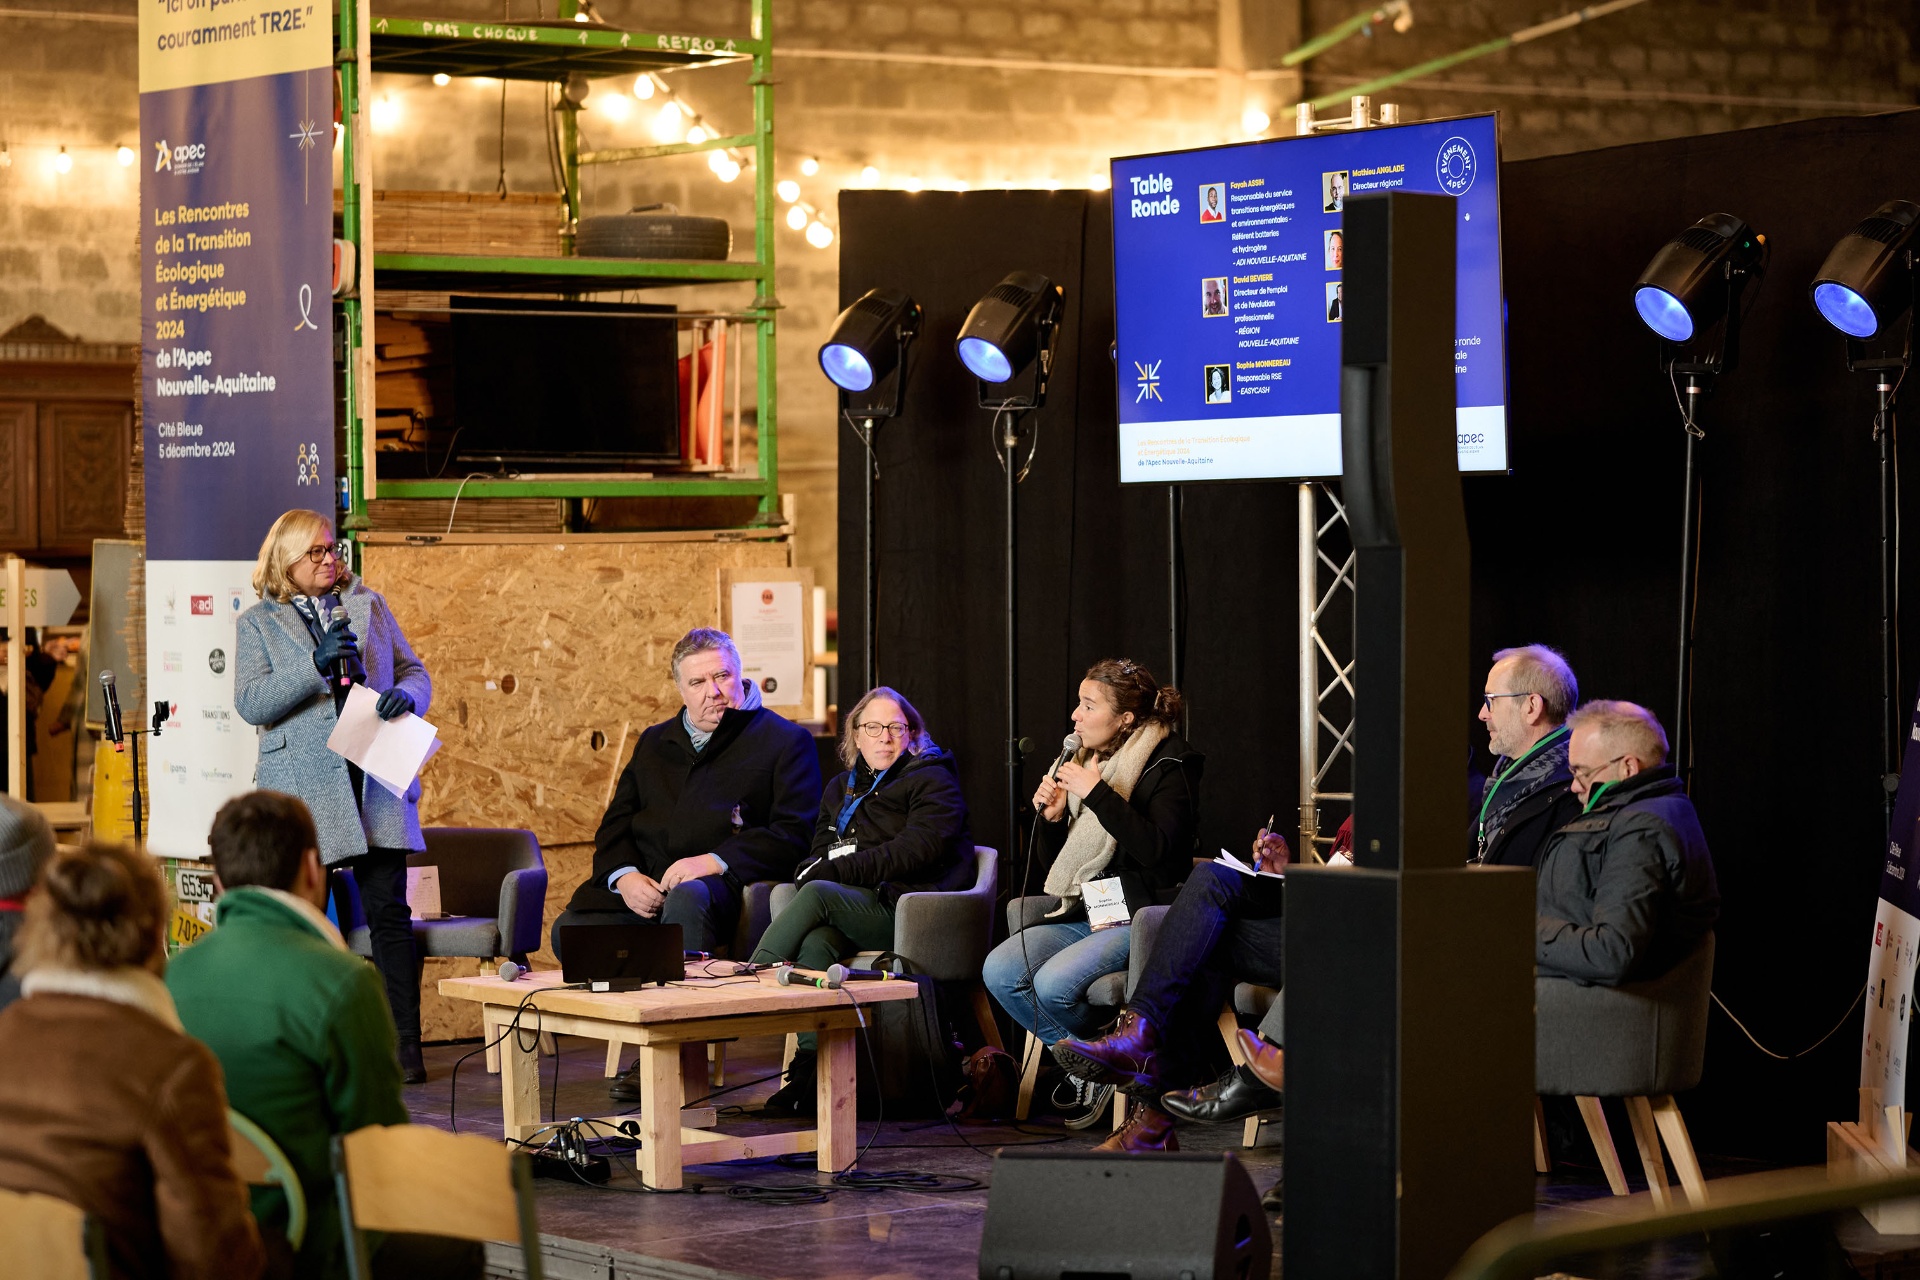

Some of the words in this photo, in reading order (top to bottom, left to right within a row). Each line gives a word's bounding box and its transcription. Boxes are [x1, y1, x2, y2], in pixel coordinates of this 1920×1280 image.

[158, 16, 256, 50] couramment
[473, 26, 539, 41] CHOQUE
[657, 34, 716, 51] RETRO
[174, 144, 206, 163] apec
[1376, 164, 1405, 174] ANGLADE
[1130, 173, 1173, 196] Table
[1352, 182, 1379, 190] Directeur
[1380, 178, 1403, 188] régional
[1447, 178, 1467, 188] APEC
[1231, 191, 1264, 202] Responsable
[1273, 189, 1293, 197] service
[1131, 195, 1180, 218] Ronde
[1231, 206, 1260, 215] transitions
[1260, 203, 1295, 212] énergétiques
[155, 208, 175, 226] Les
[178, 202, 249, 223] Rencontres
[1238, 216, 1289, 227] environnementales
[155, 235, 170, 254] de
[173, 234, 185, 253] la
[187, 228, 251, 252] Transition
[1232, 232, 1254, 241] Référent
[1255, 229, 1279, 238] batteries
[1232, 246, 1238, 254] et
[1239, 244, 1267, 254] hydrogène
[1246, 252, 1307, 266] NOUVELLE-AQUITAINE
[155, 260, 224, 285] Écologique
[1233, 276, 1249, 284] David
[1233, 288, 1258, 297] Directeur
[1259, 287, 1266, 295] de
[155, 293, 168, 312] et
[170, 287, 246, 312] Énergétique
[1234, 302, 1240, 310] et
[1241, 301, 1248, 309] de
[1234, 312, 1274, 324] professionnelle
[156, 320, 185, 340] 2024
[1238, 326, 1260, 335] RÉGION
[1238, 337, 1299, 348] NOUVELLE-AQUITAINE
[1458, 336, 1481, 346] ronde
[156, 348, 171, 368] de
[173, 347, 212, 370] l'Apec
[1236, 361, 1254, 370] Sophie
[1236, 373, 1270, 382] Responsable
[1271, 372, 1282, 380] RSE
[157, 371, 276, 397] Nouvelle-Aquitaine
[1240, 386, 1270, 395] EASYCASH
[158, 422, 176, 438] Cité
[177, 421, 203, 437] Bleue
[1457, 433, 1484, 445] apec
[159, 444, 164, 459] 5
[165, 442, 211, 458] décembre
[212, 441, 235, 457] 2024
